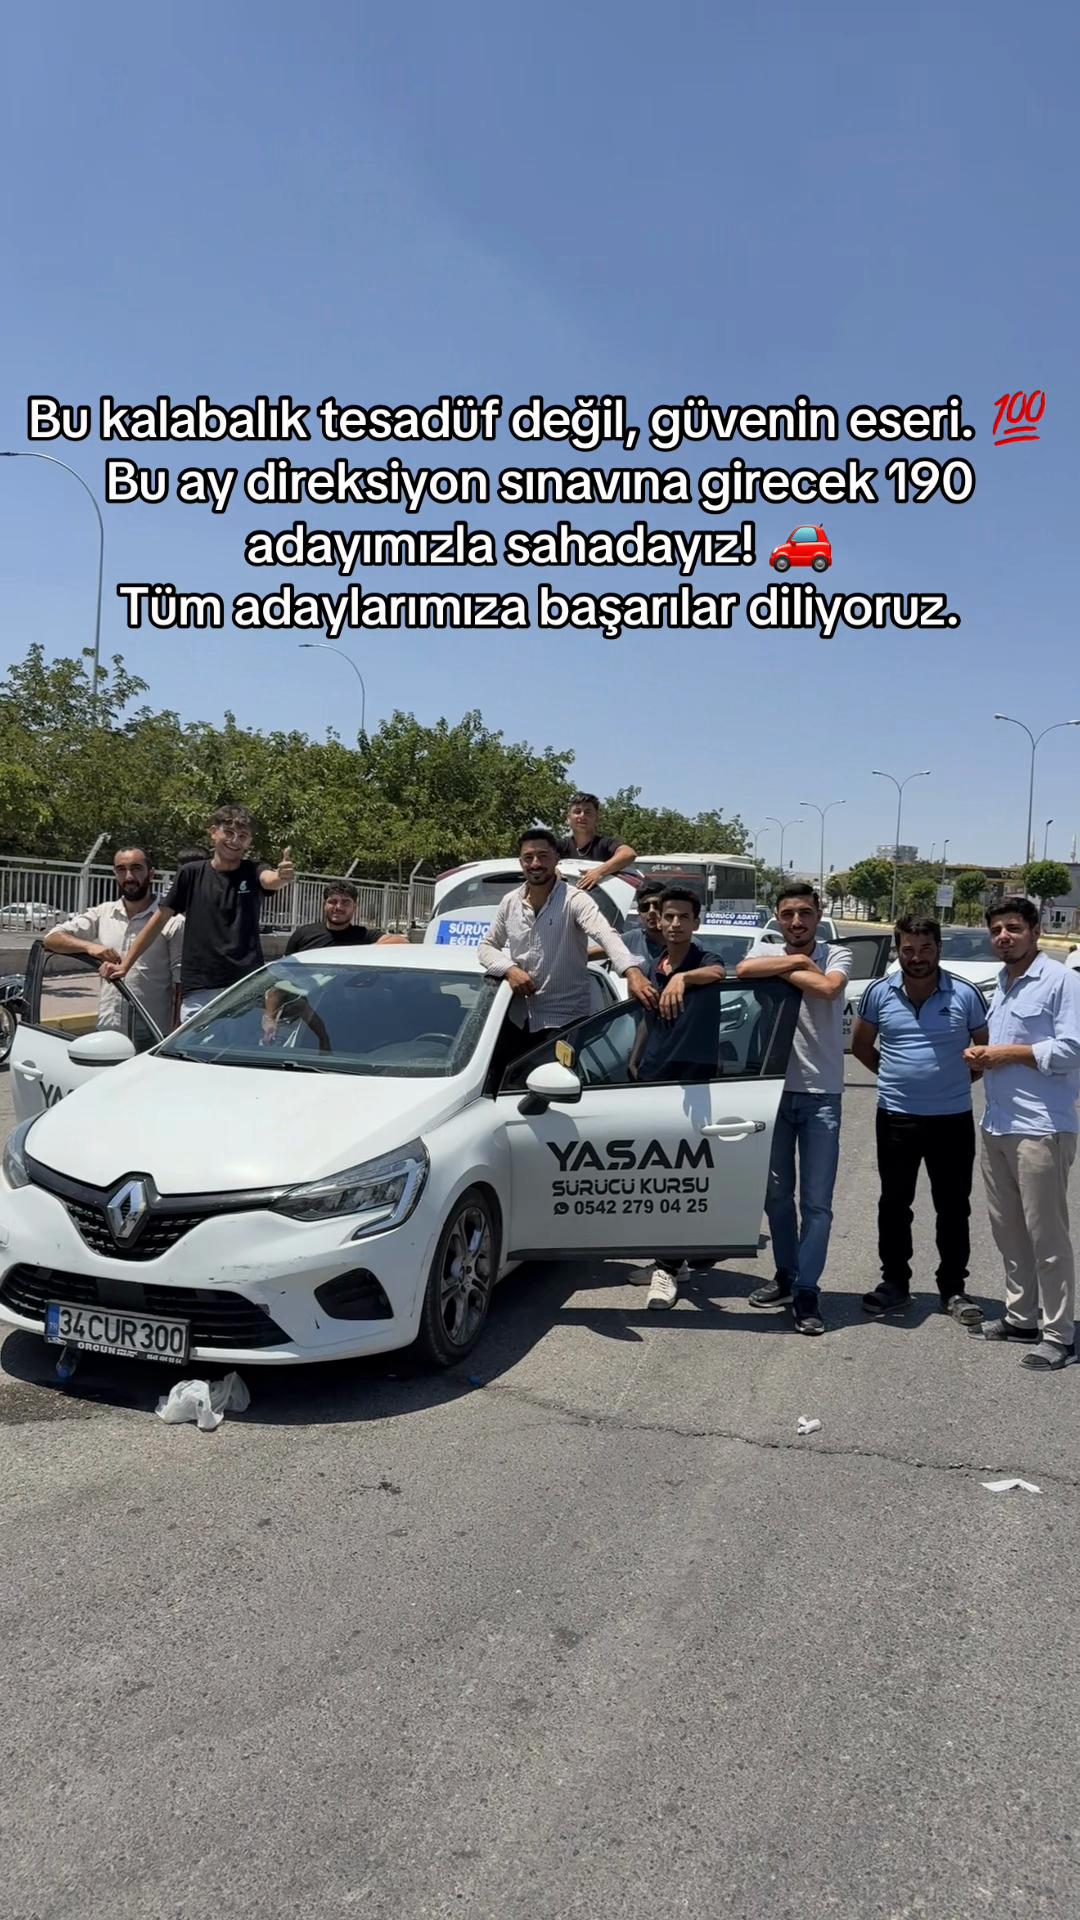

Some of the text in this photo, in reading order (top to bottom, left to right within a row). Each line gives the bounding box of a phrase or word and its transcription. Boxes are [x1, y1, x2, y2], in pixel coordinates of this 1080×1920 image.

[448, 921, 490, 935] SÜRÜC
[551, 1176, 709, 1197] SÜRÜCÜ KURSU
[574, 1198, 708, 1215] 0542 279 04 25
